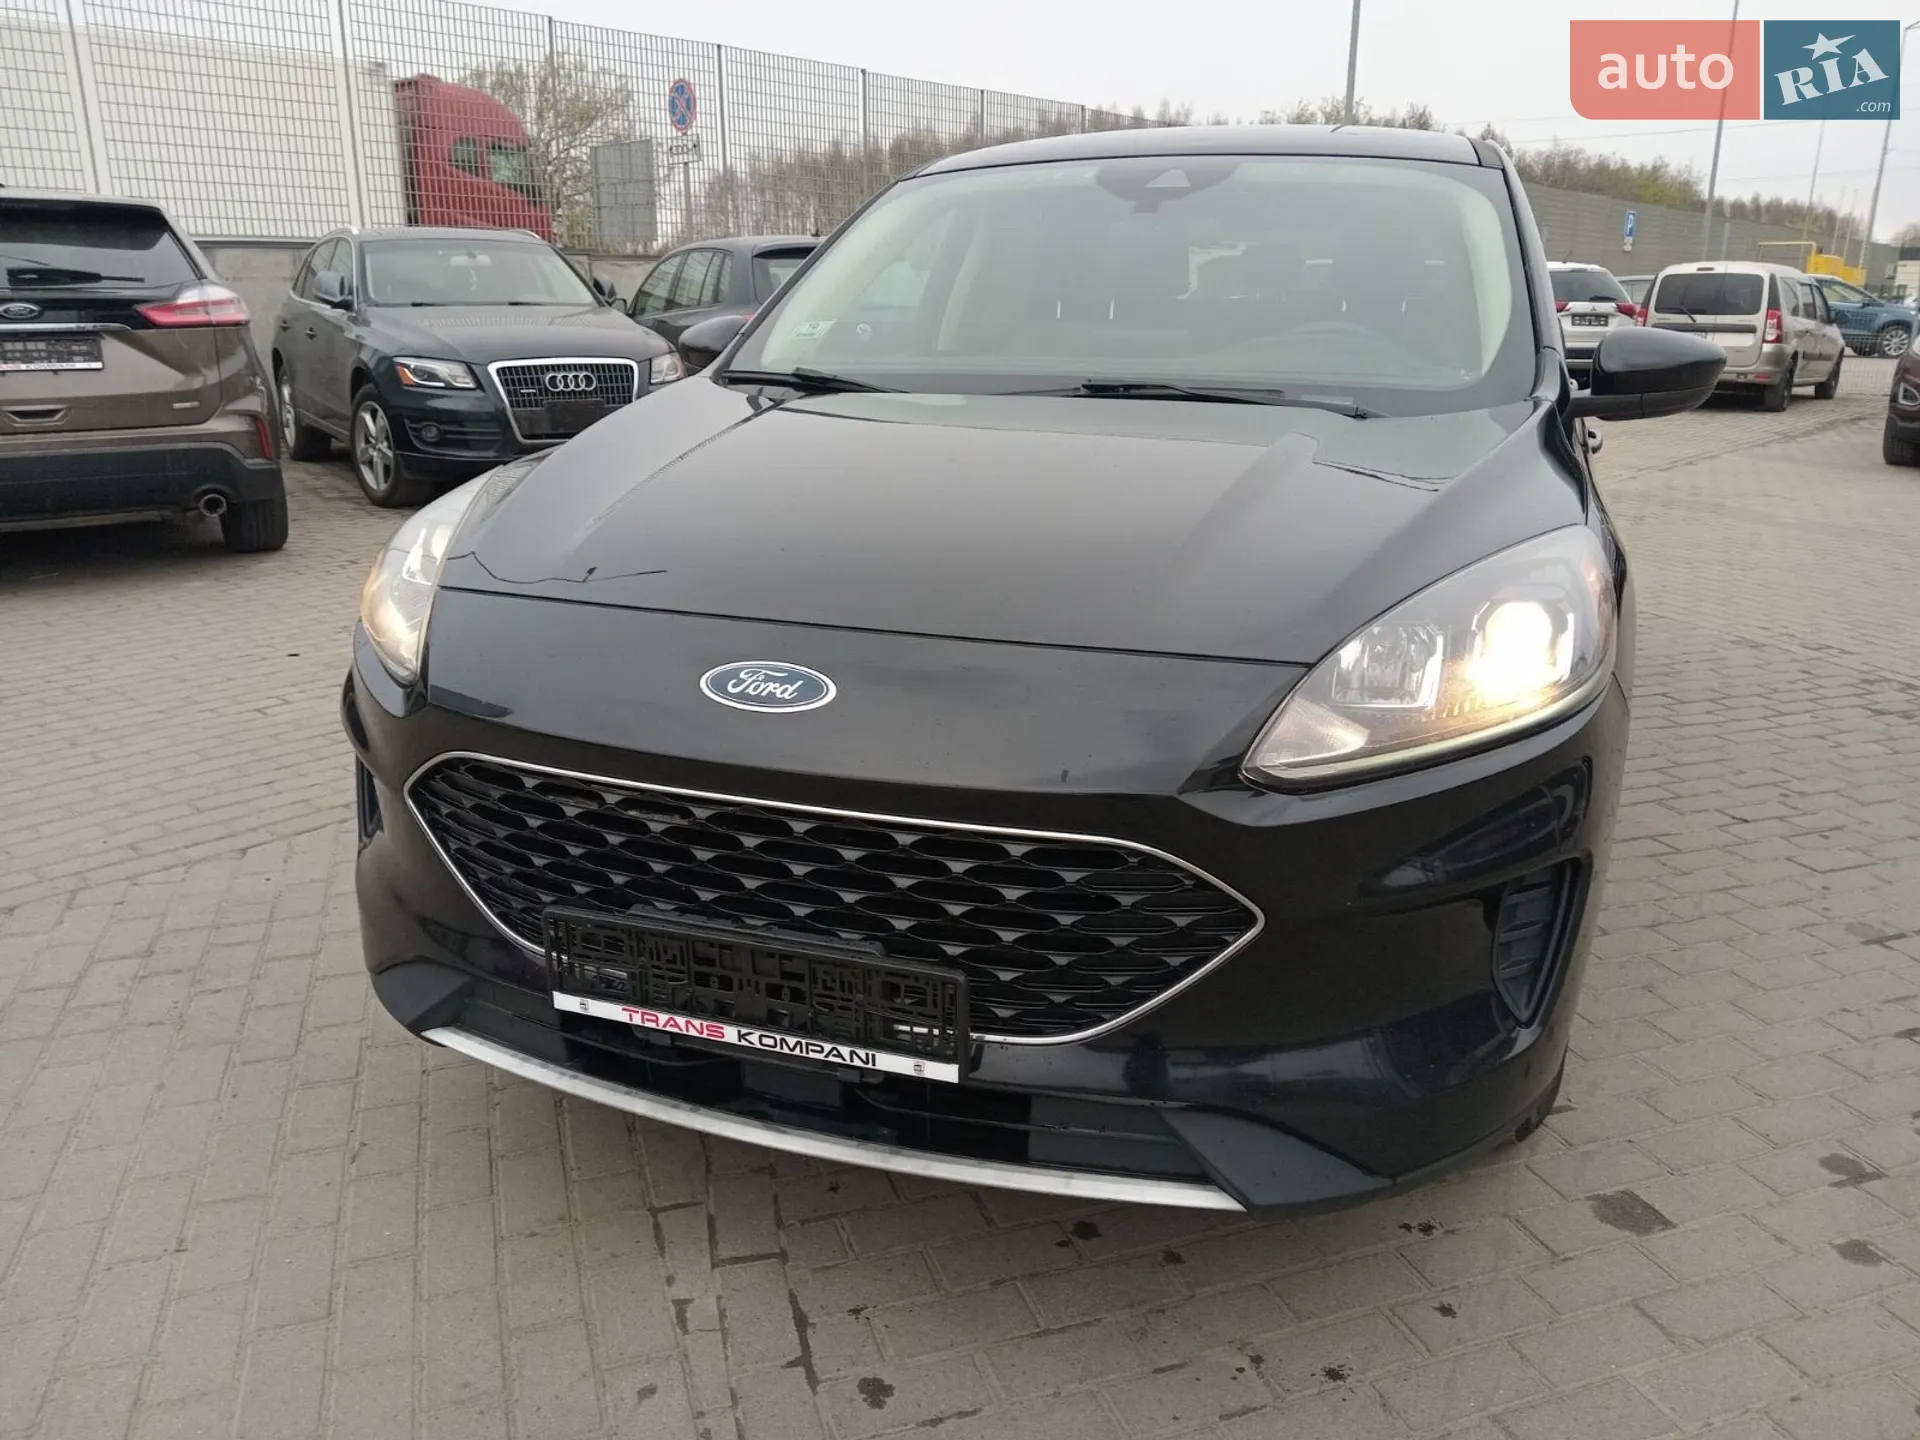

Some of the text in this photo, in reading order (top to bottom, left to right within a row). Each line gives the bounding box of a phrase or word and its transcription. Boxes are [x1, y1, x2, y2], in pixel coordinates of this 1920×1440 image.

[727, 668, 804, 699] Ford
[621, 1007, 877, 1067] TRANS KOMPANI
